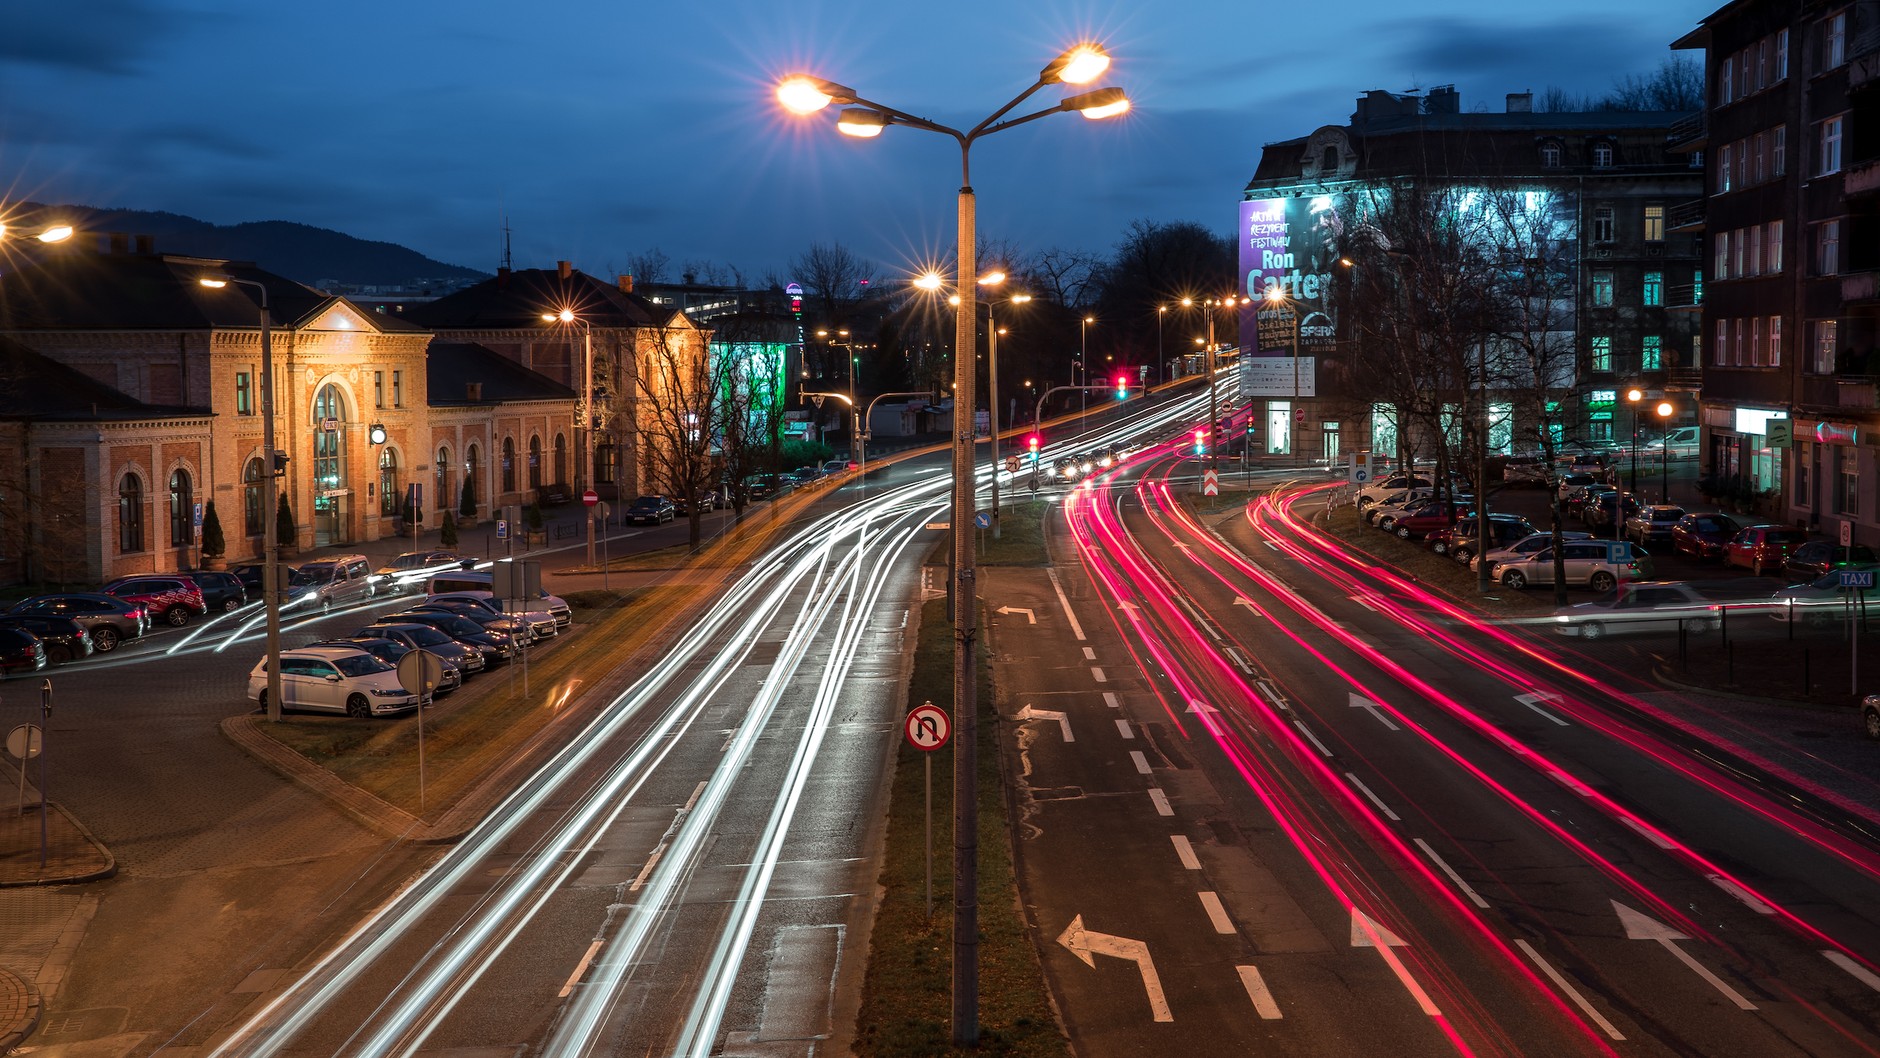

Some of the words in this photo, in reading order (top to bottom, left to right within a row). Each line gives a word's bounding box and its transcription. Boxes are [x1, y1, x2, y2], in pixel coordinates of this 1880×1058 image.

[1250, 222, 1290, 236] REZYDENT
[1263, 250, 1294, 269] Ron
[1247, 269, 1332, 301] Carter
[1257, 310, 1278, 319] LOTOS
[498, 521, 505, 531] P
[1611, 544, 1625, 561] P
[1841, 573, 1871, 585] TAXI
